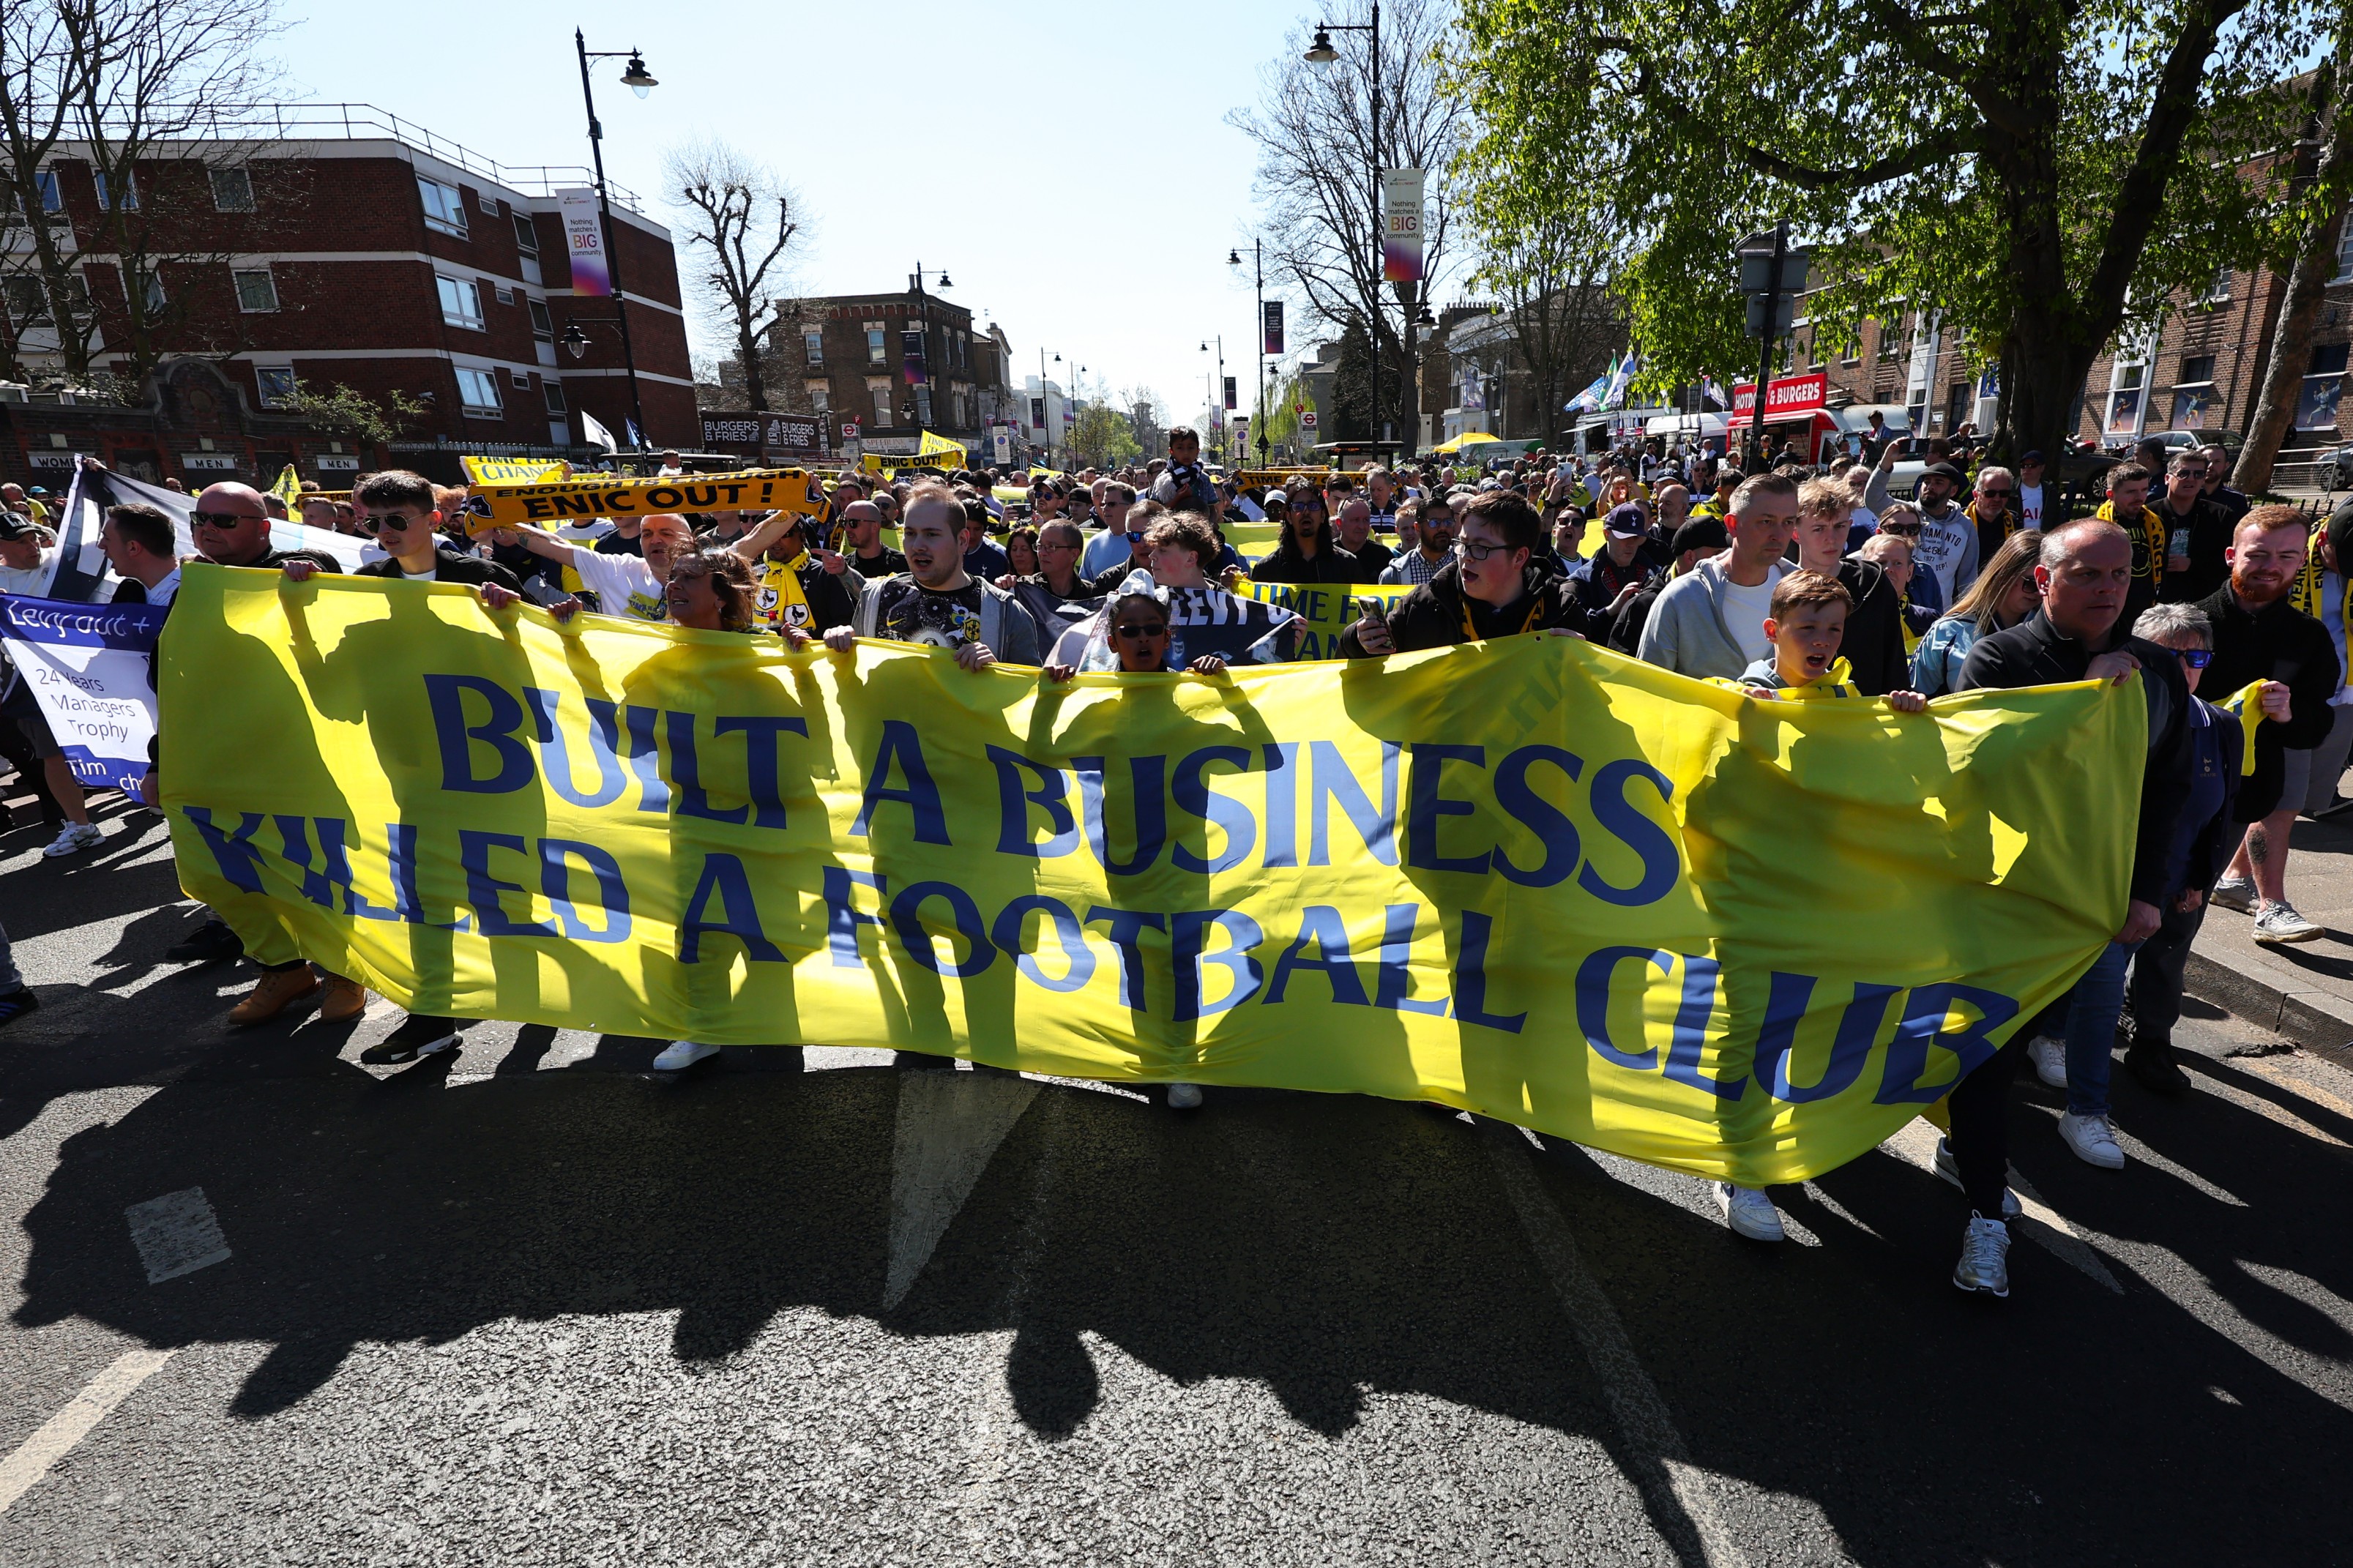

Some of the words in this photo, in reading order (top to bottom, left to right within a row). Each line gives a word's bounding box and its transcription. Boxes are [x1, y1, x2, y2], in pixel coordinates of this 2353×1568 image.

[1391, 216, 1417, 231] BIG
[573, 234, 597, 248] BIG
[1735, 391, 1767, 409] HOTDO
[1770, 390, 1775, 405] &
[1776, 381, 1820, 405] BURGERS
[704, 421, 759, 431] BURGERS
[782, 422, 815, 436] BURGERS
[704, 431, 712, 441] &
[715, 431, 747, 442] FRIES
[783, 434, 788, 444] &
[789, 434, 809, 447] FRIES
[928, 436, 945, 449] TIME
[38, 458, 75, 468] WOME
[195, 460, 223, 468] MEN
[327, 460, 351, 468] MEN
[880, 458, 909, 467] ENIC
[913, 455, 941, 466] OUT!
[496, 481, 622, 497] ENOUGH
[633, 478, 663, 488] IS
[671, 471, 800, 484] ENOUGH
[1245, 476, 1282, 485] TIME
[522, 490, 635, 518] ENIC
[646, 484, 747, 508] OUT
[1925, 527, 1961, 547] RAMNTO
[1936, 562, 1949, 572] DEPT
[1245, 583, 1330, 624] TIME
[8, 600, 72, 638] Levy
[75, 613, 127, 637] out
[35, 668, 61, 685] 24
[60, 669, 105, 692] Years
[51, 694, 136, 717] Managers
[67, 719, 128, 743] Trophy
[65, 758, 107, 776] Tim
[119, 774, 142, 791] ch
[423, 673, 809, 830] BUILT
[847, 720, 952, 846] A
[985, 740, 1681, 907] BUSINESS
[182, 806, 633, 944] KILLED
[679, 853, 789, 963] A
[822, 865, 1528, 1035] FOOTBALL
[1575, 945, 2020, 1105] CLUB
